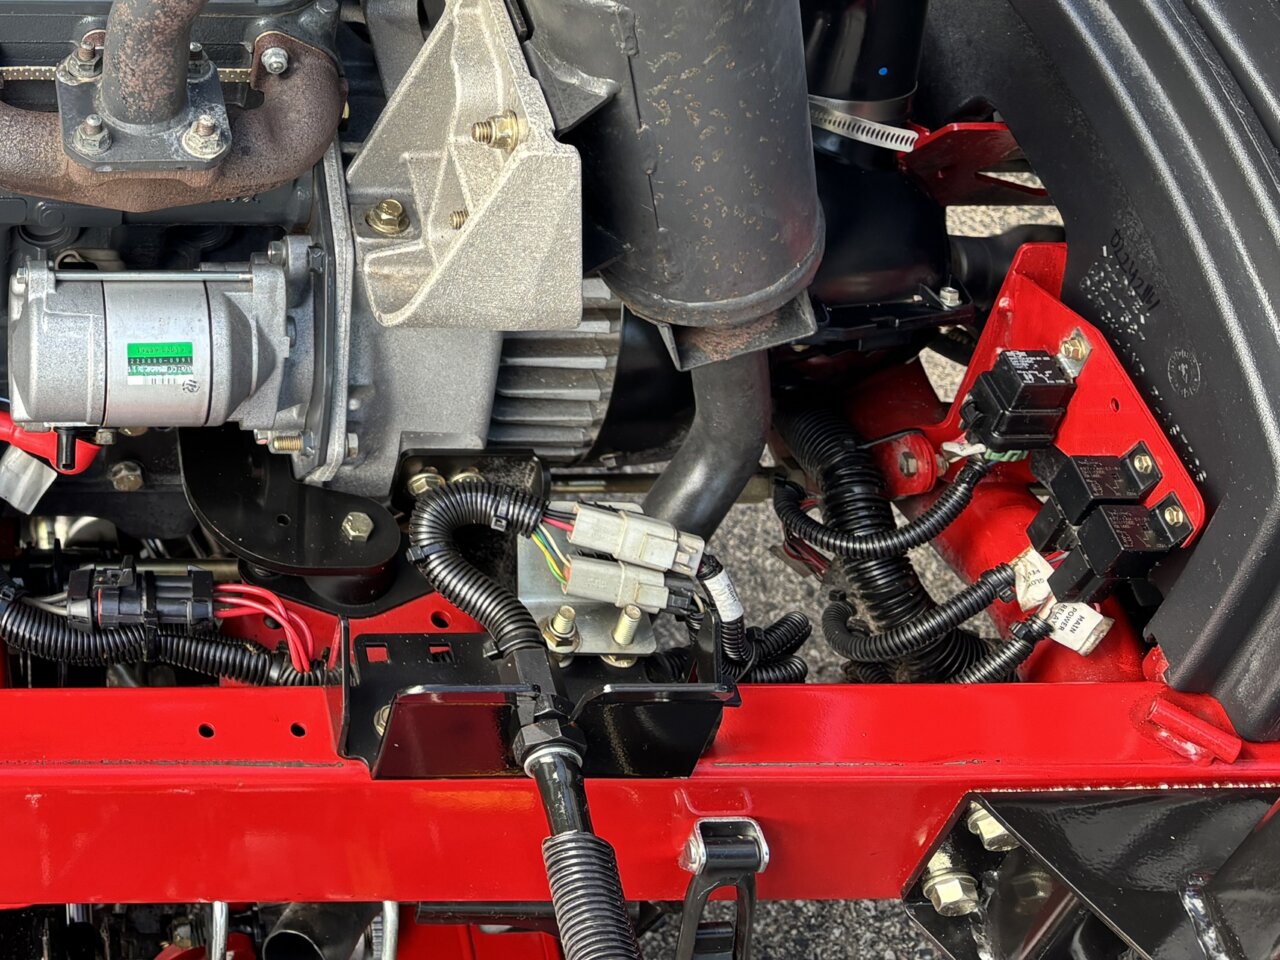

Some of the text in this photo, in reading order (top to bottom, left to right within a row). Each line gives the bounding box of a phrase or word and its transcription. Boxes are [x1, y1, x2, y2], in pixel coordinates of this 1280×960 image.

[1051, 603, 1068, 627] RELAY
[1058, 606, 1078, 633] POWER
[1068, 615, 1086, 635] MAIN
